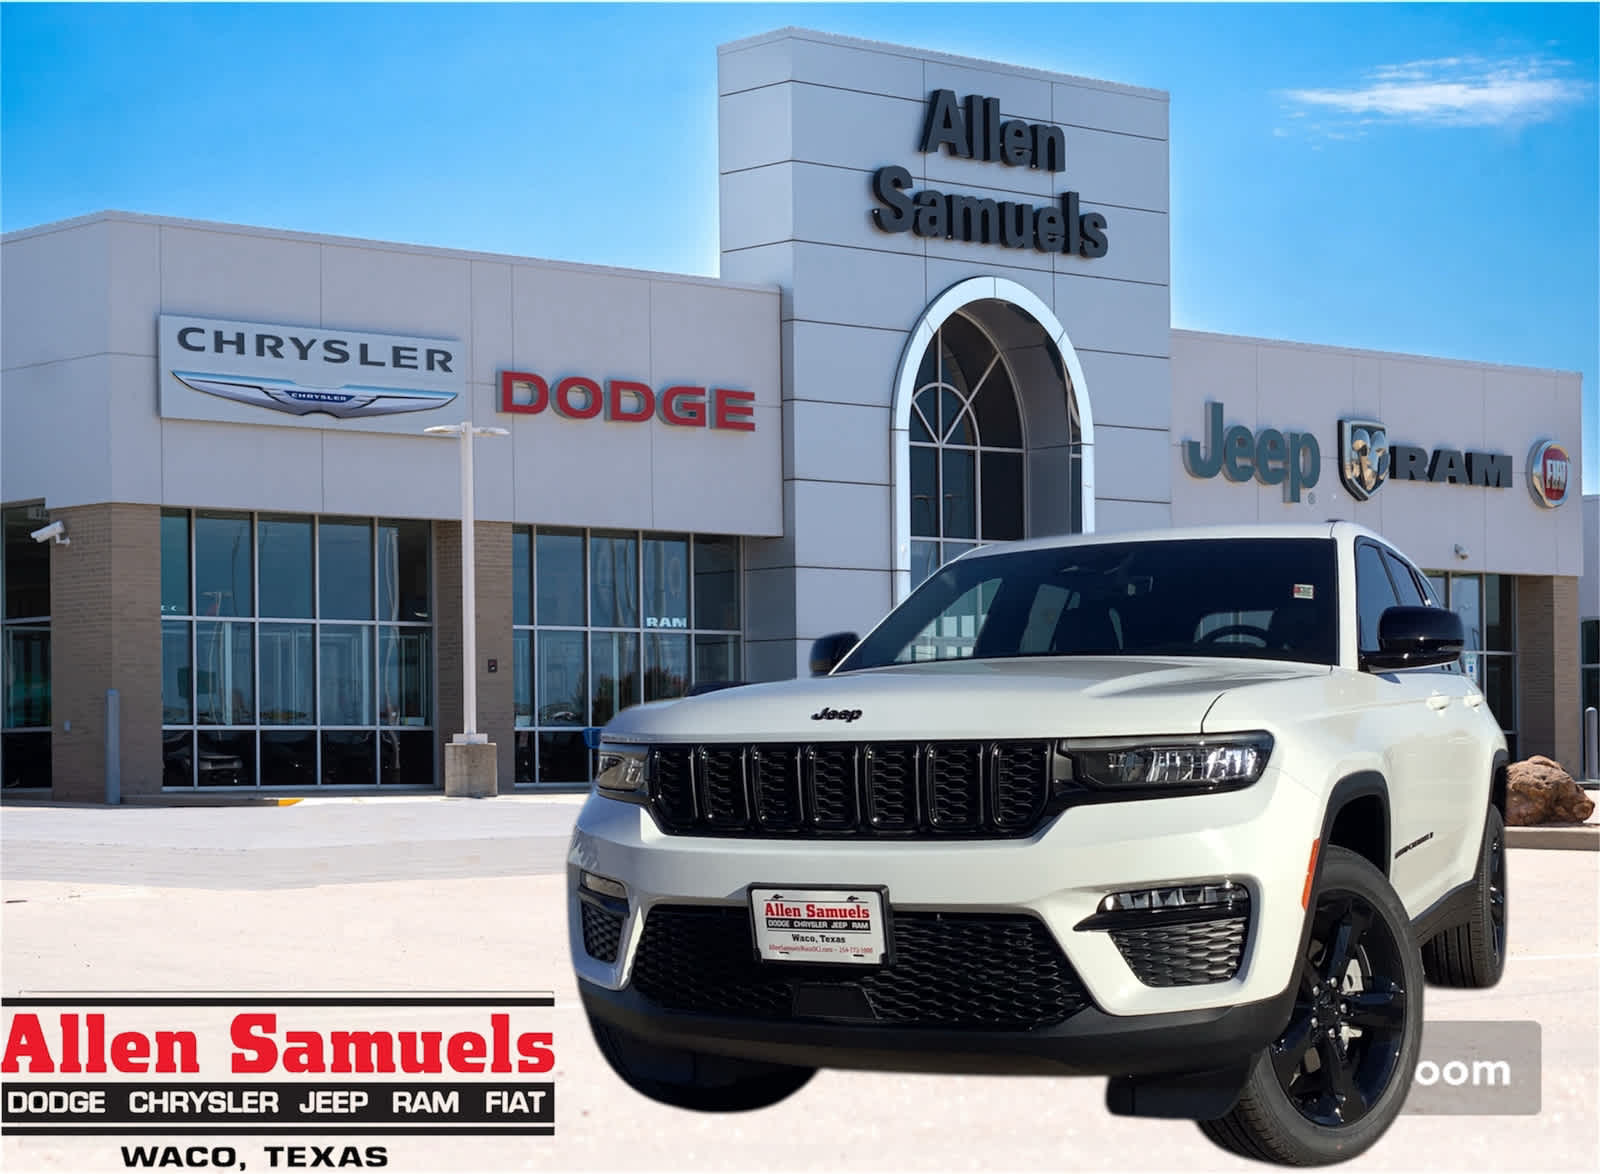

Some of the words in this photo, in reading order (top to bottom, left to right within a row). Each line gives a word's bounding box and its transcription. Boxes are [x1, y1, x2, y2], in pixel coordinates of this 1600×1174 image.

[918, 89, 1066, 172] Allen
[872, 165, 1109, 258] Samuels
[177, 326, 453, 373] CHRYSLER
[291, 392, 347, 401] CHRYSLER
[496, 370, 756, 432] DODGE
[1182, 401, 1321, 504] Jeep
[1388, 445, 1513, 489] RAM
[1546, 459, 1567, 490] FIAT
[646, 616, 687, 628] RAM
[810, 707, 863, 723] Jeep
[765, 902, 801, 917] Allen
[806, 904, 870, 918] Samuels
[767, 920, 790, 928] DODGE
[793, 921, 828, 929] CHRYSLER
[851, 922, 869, 930] RAM
[791, 933, 818, 943] Waco,
[819, 935, 846, 943] Texas
